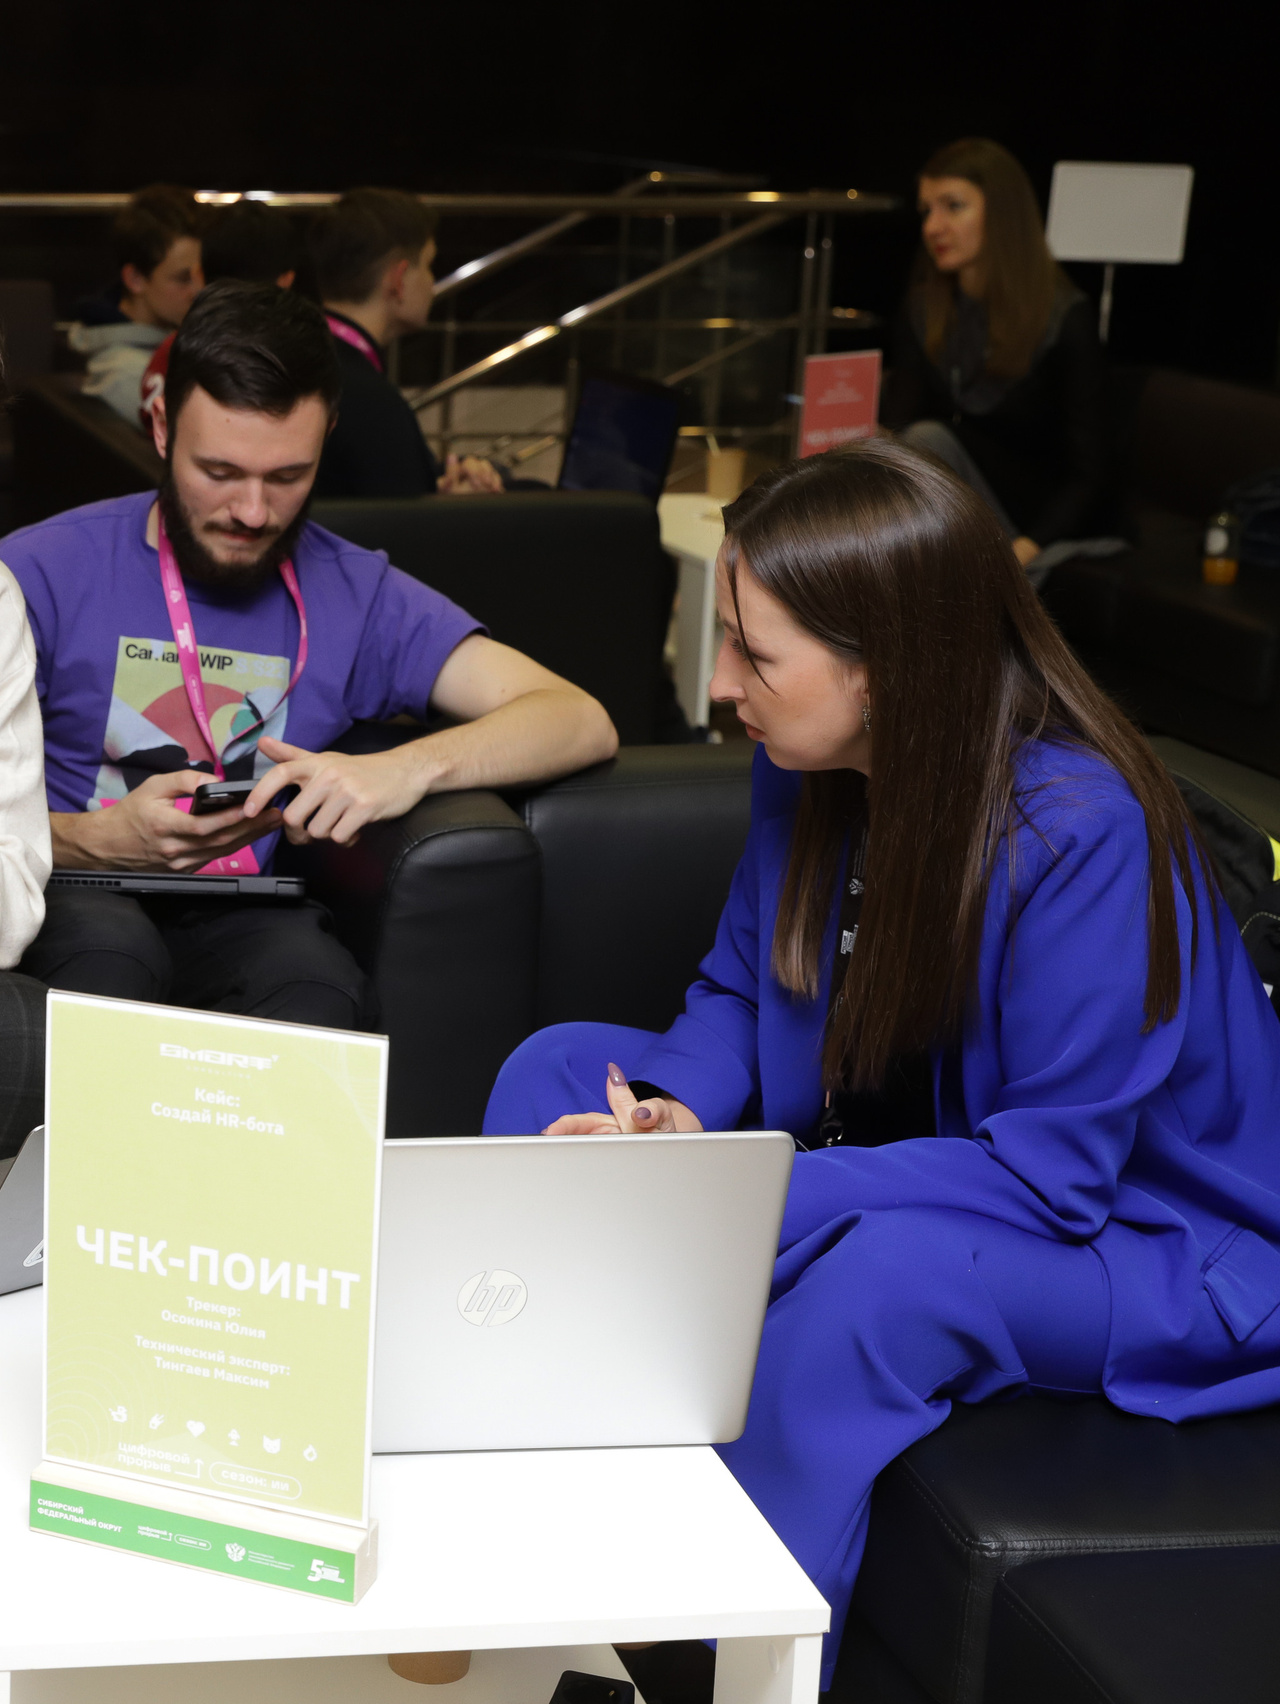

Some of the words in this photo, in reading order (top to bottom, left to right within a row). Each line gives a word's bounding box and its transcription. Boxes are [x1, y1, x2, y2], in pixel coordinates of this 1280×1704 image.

[200, 653, 233, 670] WIP
[194, 1087, 241, 1108] Кейс:
[151, 1102, 211, 1124] Создай
[216, 1111, 285, 1136] HR-бота
[76, 1225, 361, 1310] ЧЕК-ПОИНТ
[186, 1296, 242, 1318] Трекер:
[464, 1270, 523, 1327] hp
[161, 1309, 222, 1331] Осокина
[225, 1321, 266, 1340] Юлия
[134, 1334, 226, 1364] Технический
[229, 1354, 291, 1376] эксперт:
[154, 1356, 210, 1378] Тингаев
[214, 1367, 270, 1390] Максим
[117, 1441, 191, 1465] цифровой
[117, 1453, 172, 1473] прорыв
[221, 1469, 267, 1487] сезон:
[271, 1479, 290, 1492] ии
[37, 1498, 84, 1515] СИБИРСКИЙ
[36, 1507, 97, 1527] ФЕДЕРАЛЬНЫЙ
[98, 1521, 123, 1533] ОКРУГ
